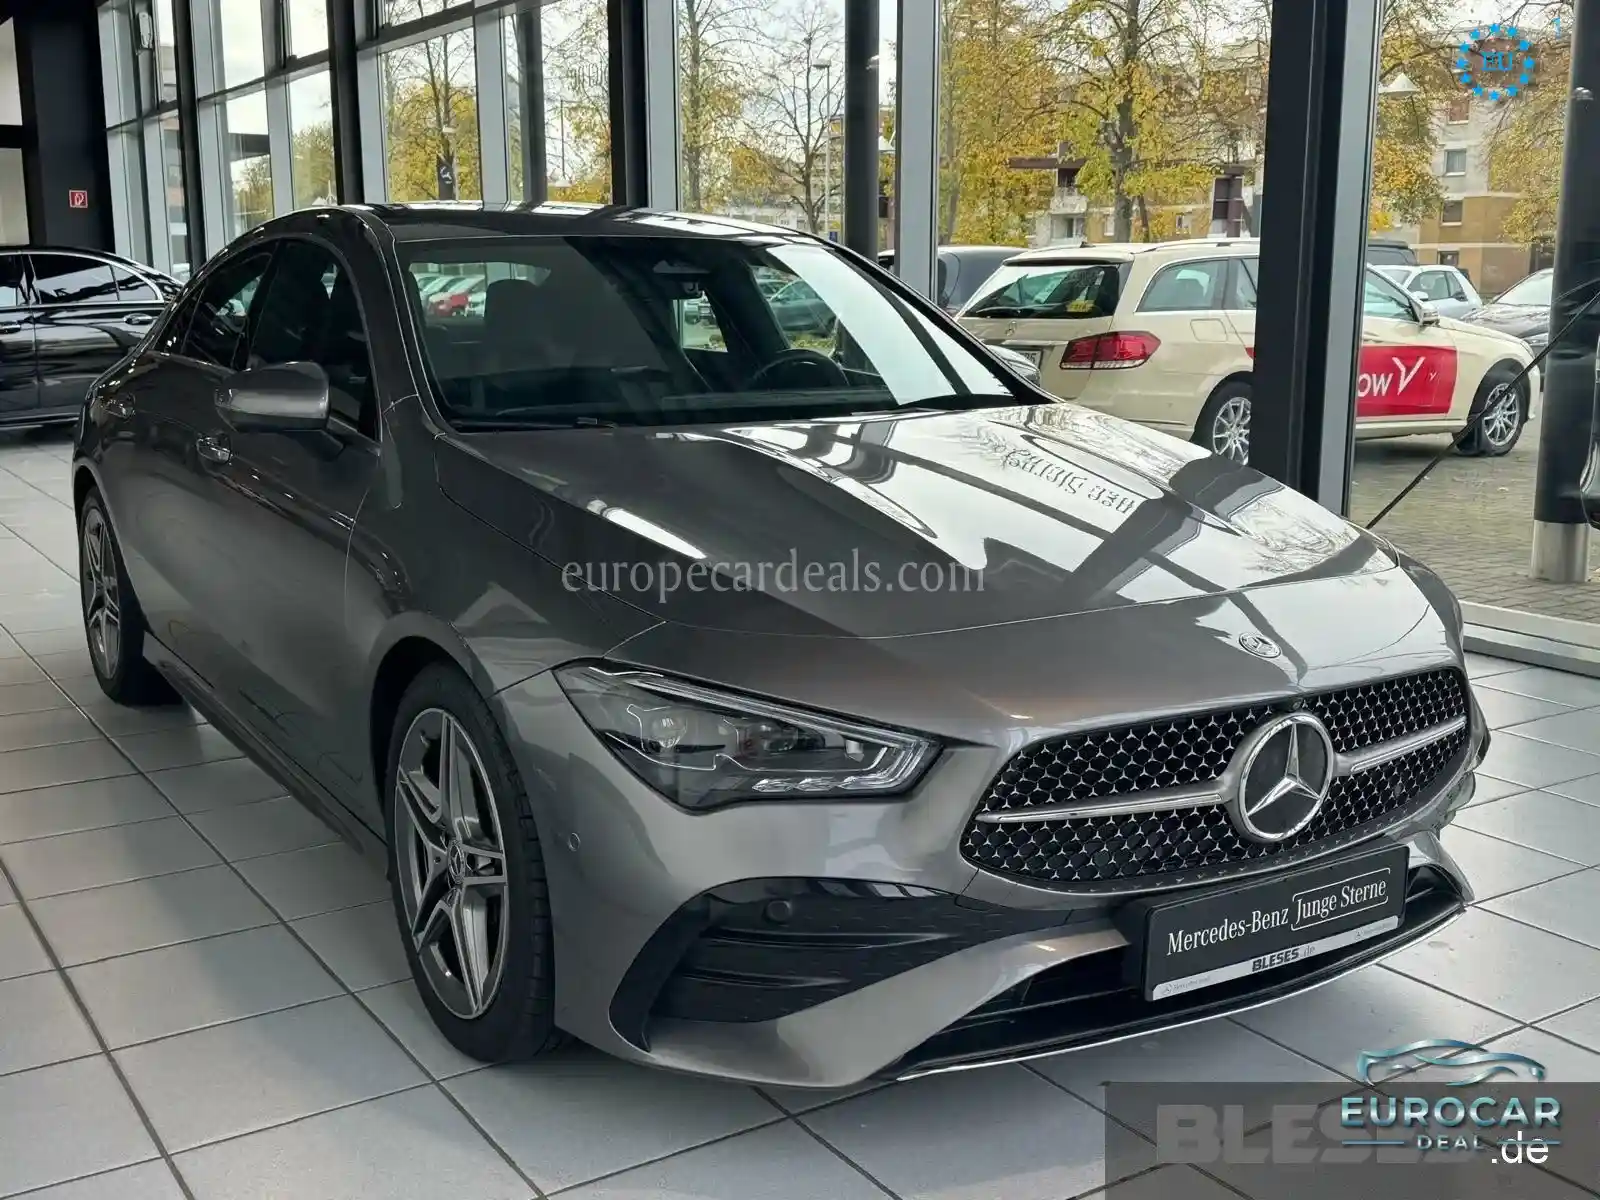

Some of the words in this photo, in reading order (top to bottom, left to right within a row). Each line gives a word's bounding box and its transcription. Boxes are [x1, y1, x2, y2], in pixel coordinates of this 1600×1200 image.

[1167, 907, 1289, 956] Mercedes-Benz
[1294, 896, 1337, 925] Junge
[1341, 879, 1386, 908] Sterne
[1252, 947, 1300, 972] BLESES
